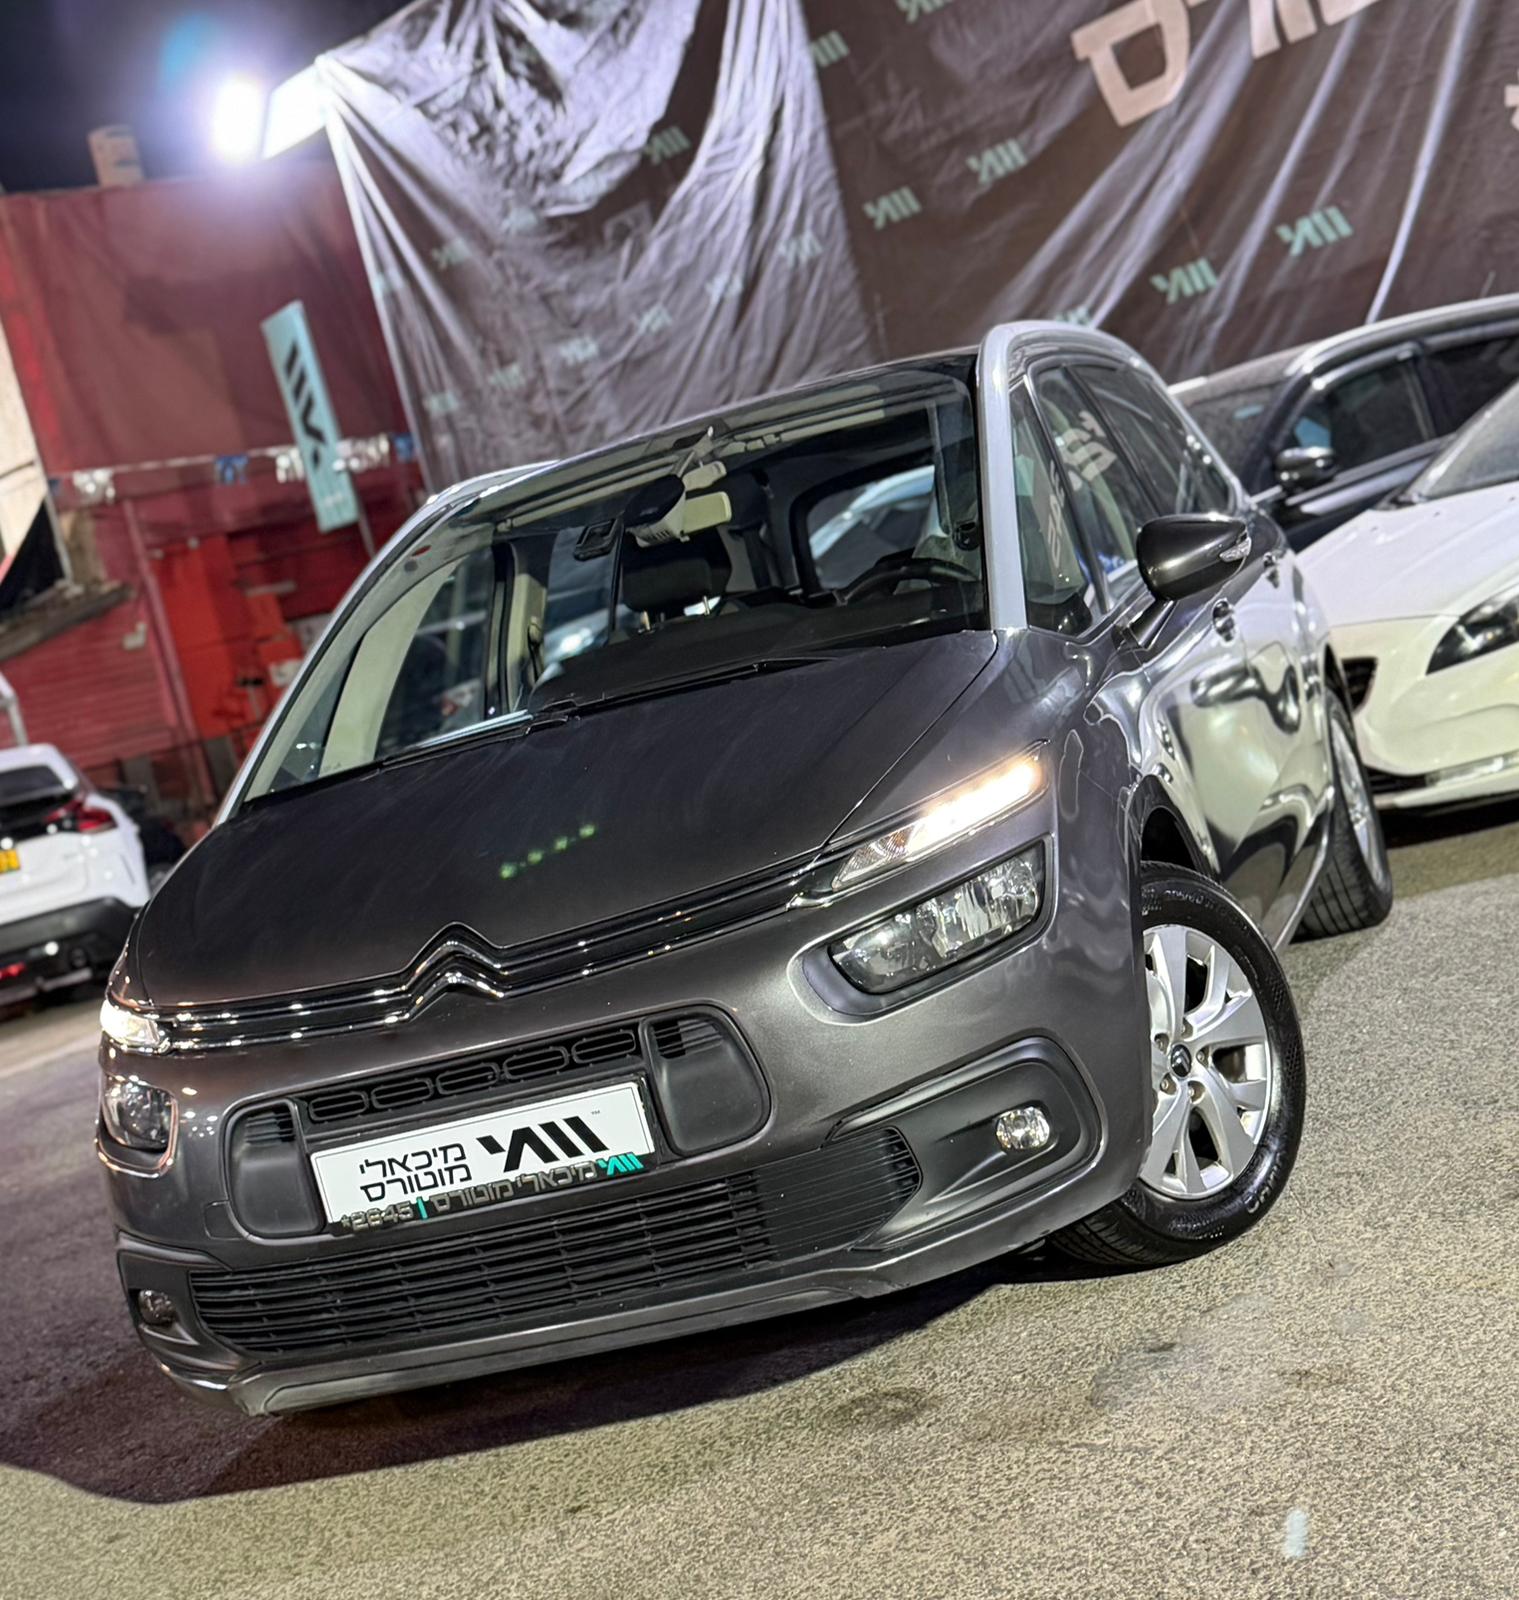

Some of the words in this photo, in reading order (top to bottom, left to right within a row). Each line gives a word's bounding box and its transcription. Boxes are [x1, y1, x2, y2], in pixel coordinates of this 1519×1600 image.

[359, 1142, 467, 1178] מיכאלי
[515, 1160, 598, 1194] מיכאלי
[360, 1163, 472, 1202] מוטורס
[429, 1178, 515, 1212] מוטורס
